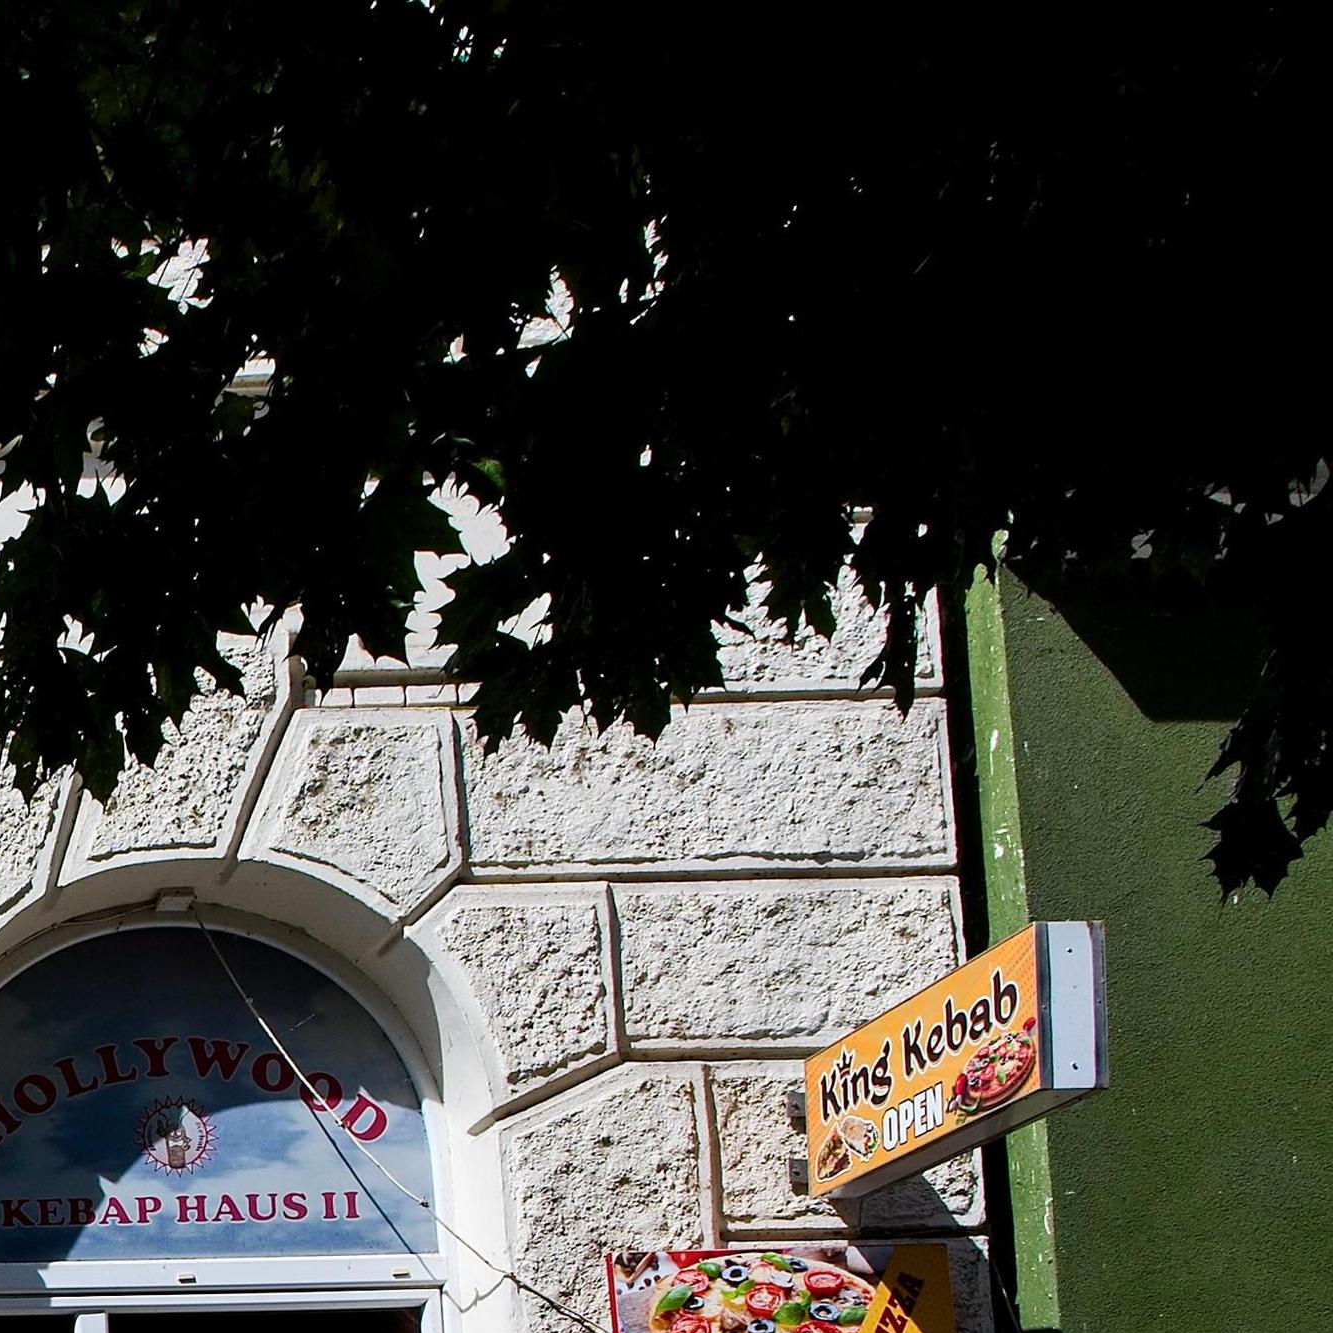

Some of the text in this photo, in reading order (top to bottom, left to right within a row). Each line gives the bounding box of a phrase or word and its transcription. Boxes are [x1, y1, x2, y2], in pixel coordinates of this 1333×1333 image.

[820, 969, 1017, 1121] King Kebab
[882, 1083, 944, 1151] OPEN
[0, 1191, 360, 1228] KEBAP HAUS II
